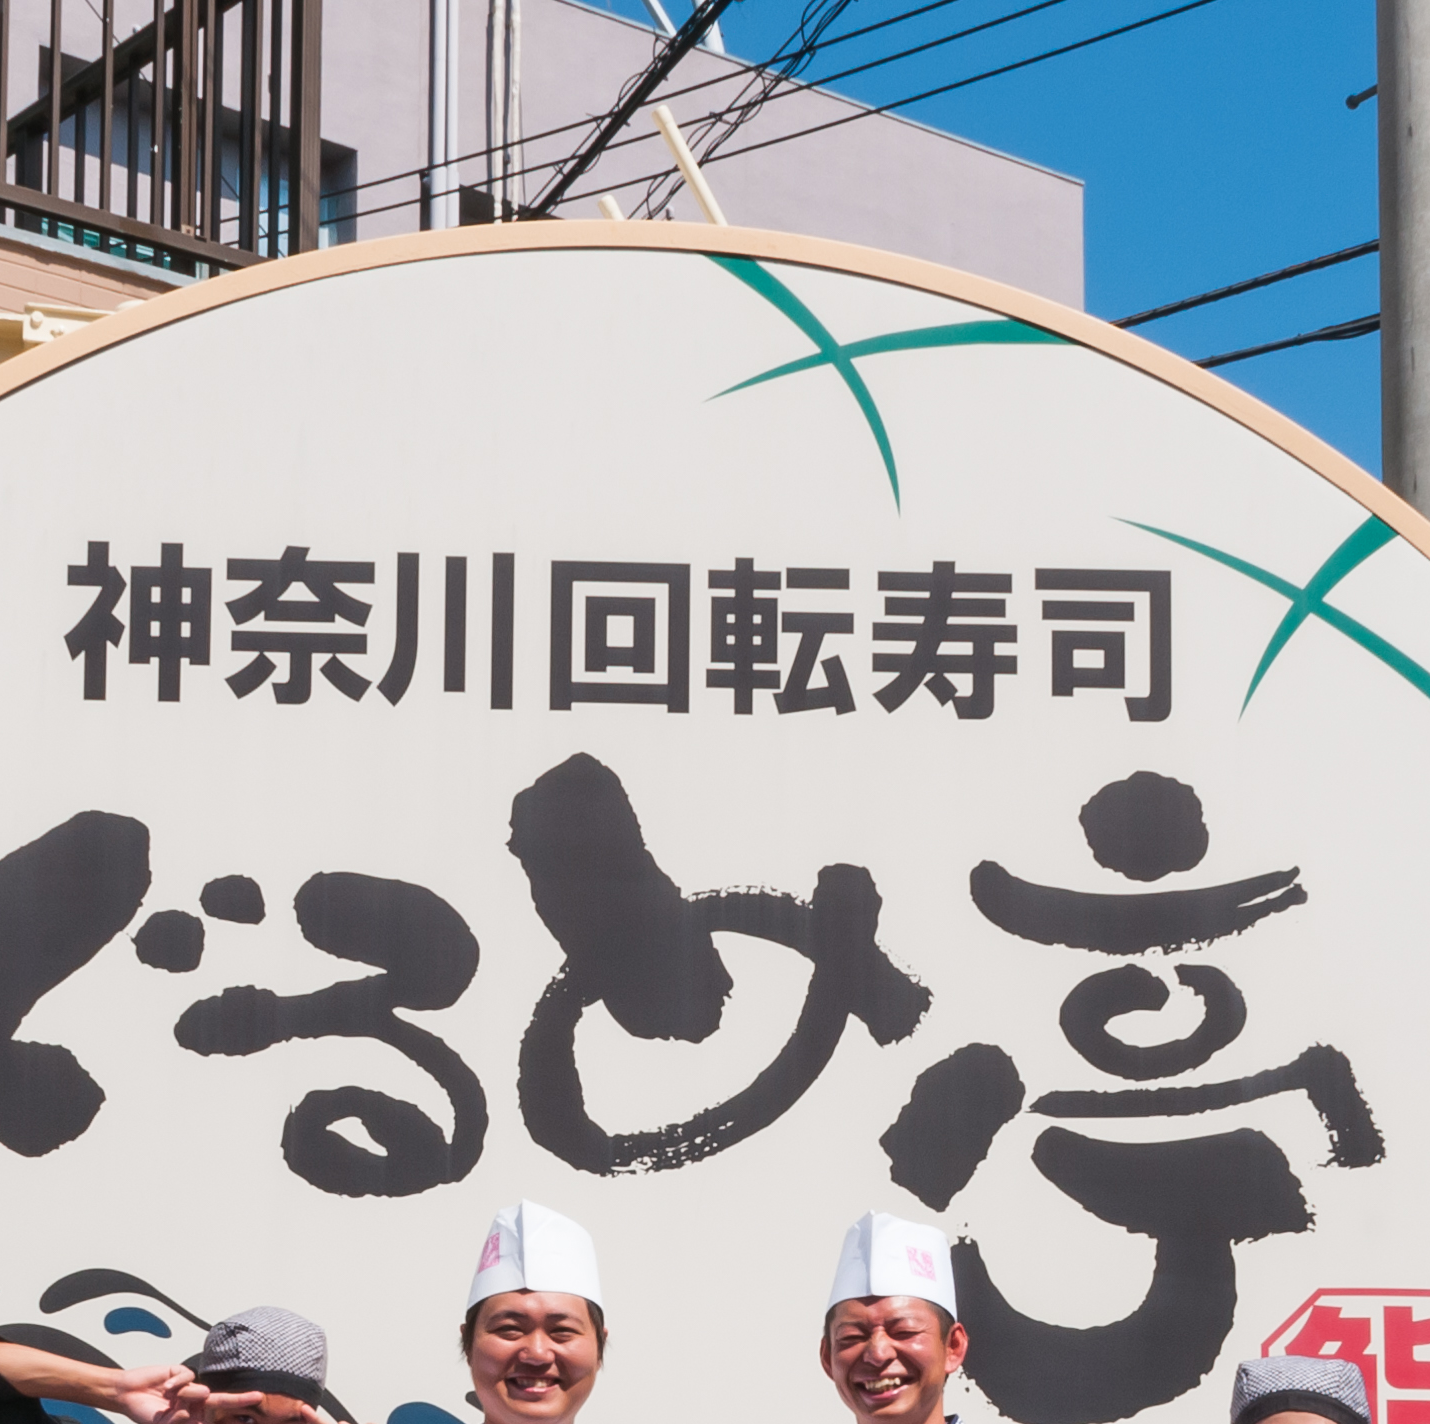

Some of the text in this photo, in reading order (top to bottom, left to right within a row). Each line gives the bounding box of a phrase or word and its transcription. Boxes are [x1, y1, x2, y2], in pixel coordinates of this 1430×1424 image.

[65, 540, 1173, 722] 神奈川回転寿司
